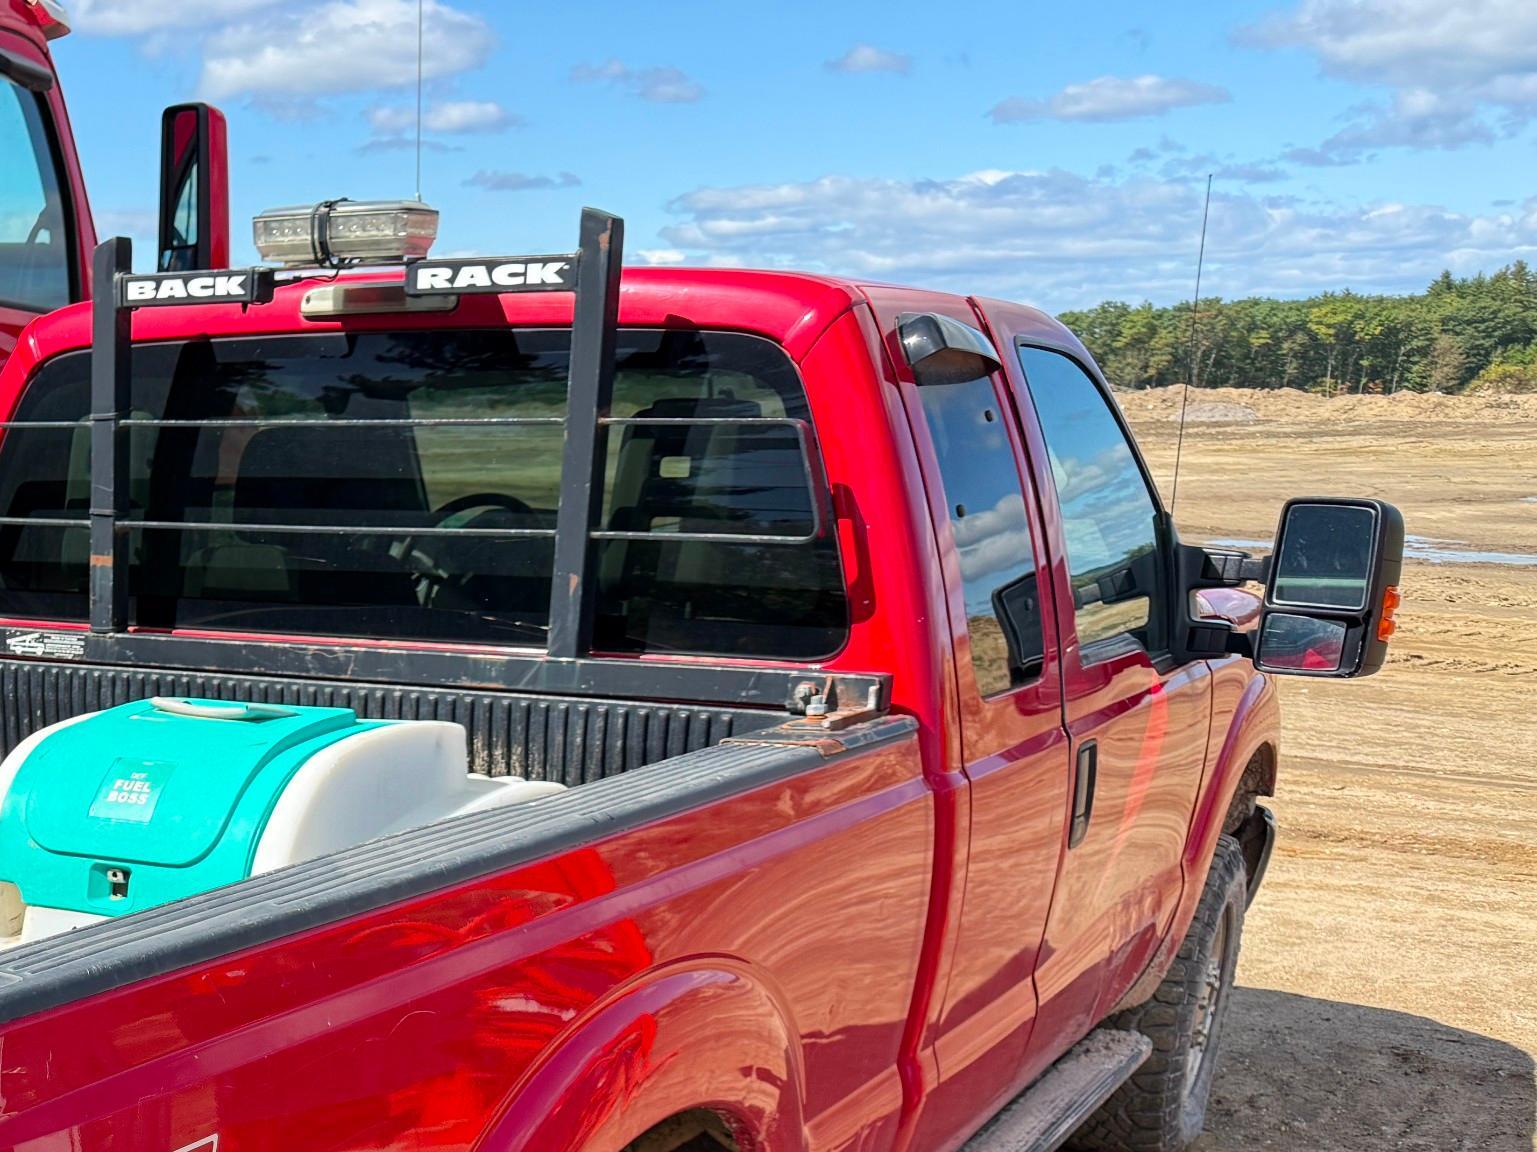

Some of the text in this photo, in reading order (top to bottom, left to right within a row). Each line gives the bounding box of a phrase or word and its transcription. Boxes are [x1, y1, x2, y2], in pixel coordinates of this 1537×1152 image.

[126, 261, 568, 301] BACK RACK
[113, 778, 152, 793] FUEL
[106, 790, 149, 805] BOSS
